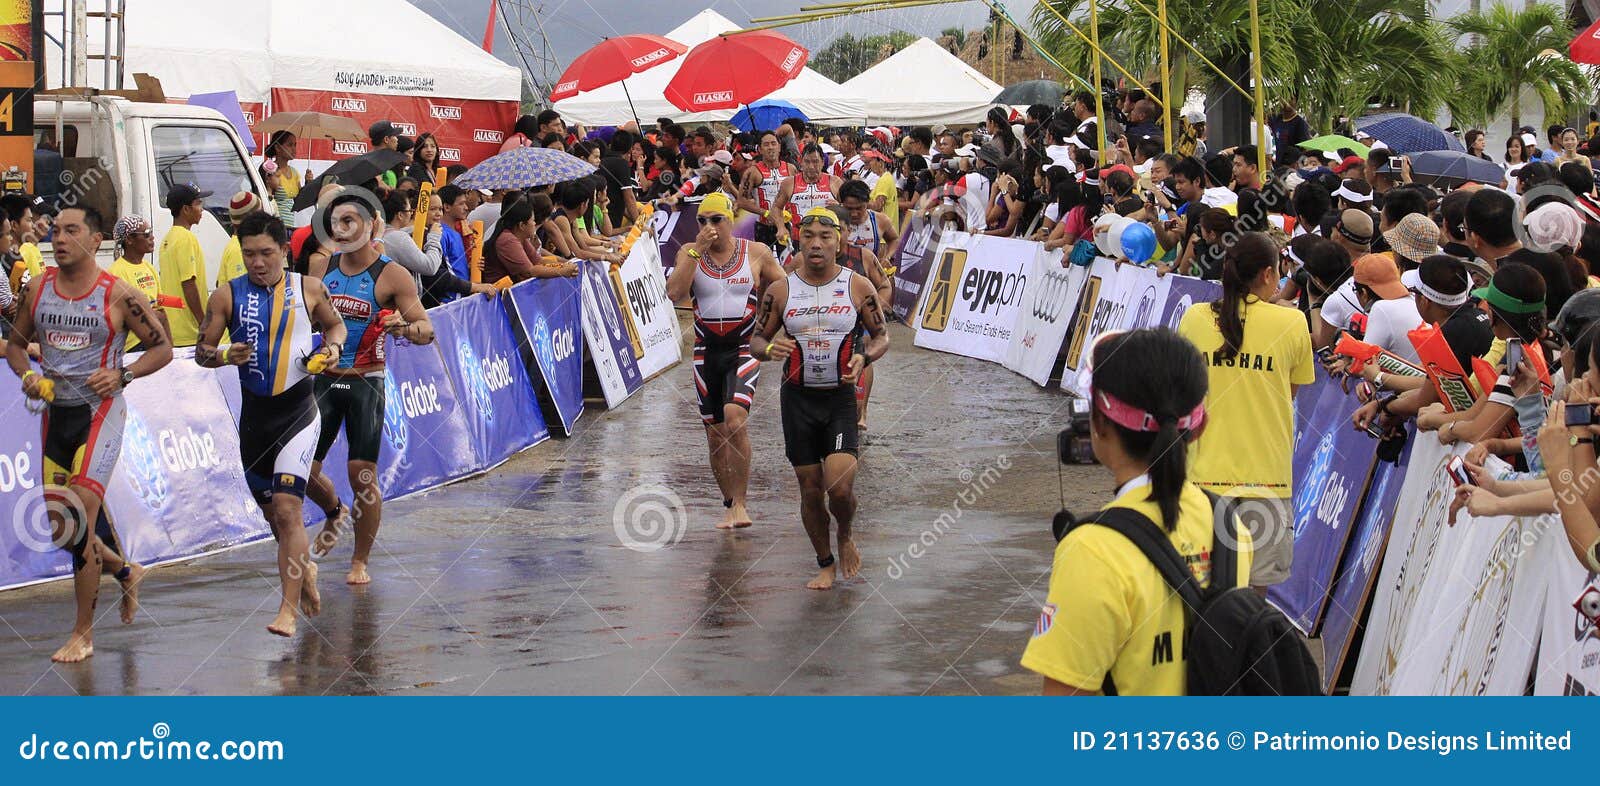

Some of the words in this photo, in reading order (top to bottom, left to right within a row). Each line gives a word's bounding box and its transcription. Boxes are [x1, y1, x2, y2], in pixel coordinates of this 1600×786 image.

[333, 99, 365, 111] ALASKA
[694, 92, 732, 103] ALASKA
[474, 130, 503, 142] ALASKA
[334, 142, 366, 154] ALASKA
[440, 149, 460, 161] ASKA
[962, 263, 1027, 315] eyp.ph
[331, 298, 369, 313] MMER
[952, 319, 965, 332] Your
[965, 320, 983, 335] Search
[982, 323, 999, 338] Ends
[552, 326, 575, 362] Globe
[807, 340, 831, 348] FRS
[482, 352, 514, 392] Globe
[401, 378, 442, 419] Globe
[159, 426, 219, 473] Globe
[1317, 471, 1350, 530] Globe
